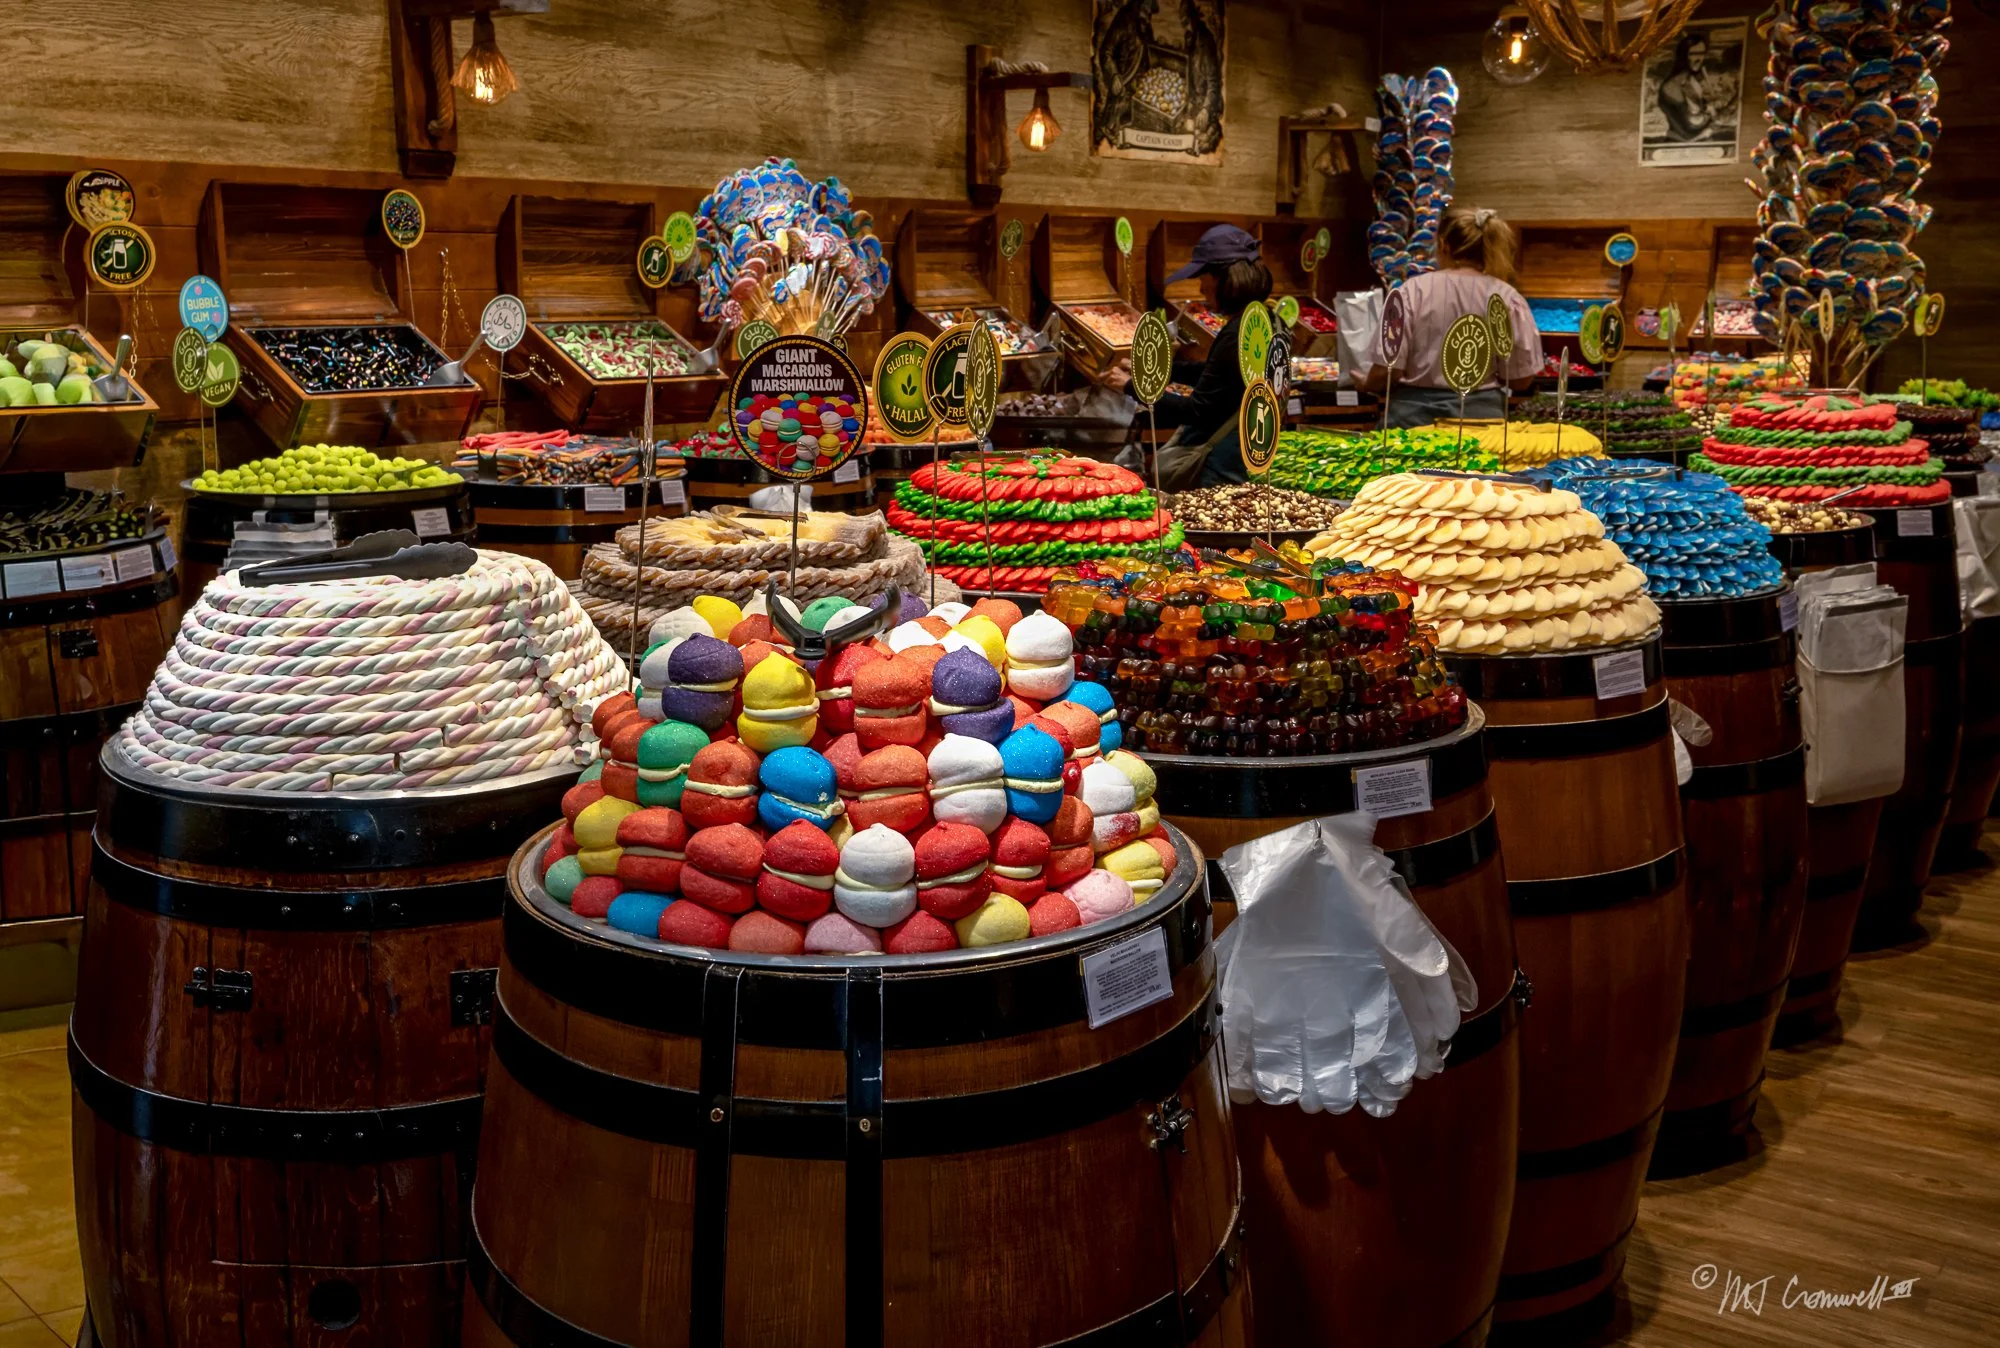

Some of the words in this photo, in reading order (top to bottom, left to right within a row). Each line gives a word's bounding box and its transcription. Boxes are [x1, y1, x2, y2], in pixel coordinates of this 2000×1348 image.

[109, 272, 132, 280] FREE
[186, 296, 220, 311] BUBBLE
[191, 312, 210, 323] GUM
[1242, 313, 1260, 352] GLUTEN
[1450, 324, 1486, 350] GLUTEN
[178, 335, 206, 356] GLUTE
[945, 336, 970, 352] LACT
[1135, 324, 1164, 357] GLUTEN
[775, 348, 818, 363] GIANT
[762, 364, 833, 378] MACARONS
[886, 353, 915, 375] GLUTEN
[204, 382, 232, 398] VEGAN
[751, 379, 844, 392] MARSHMALLOW
[890, 405, 928, 423] HALAL
[947, 406, 965, 418] FRE
[1251, 448, 1266, 460] FREE
